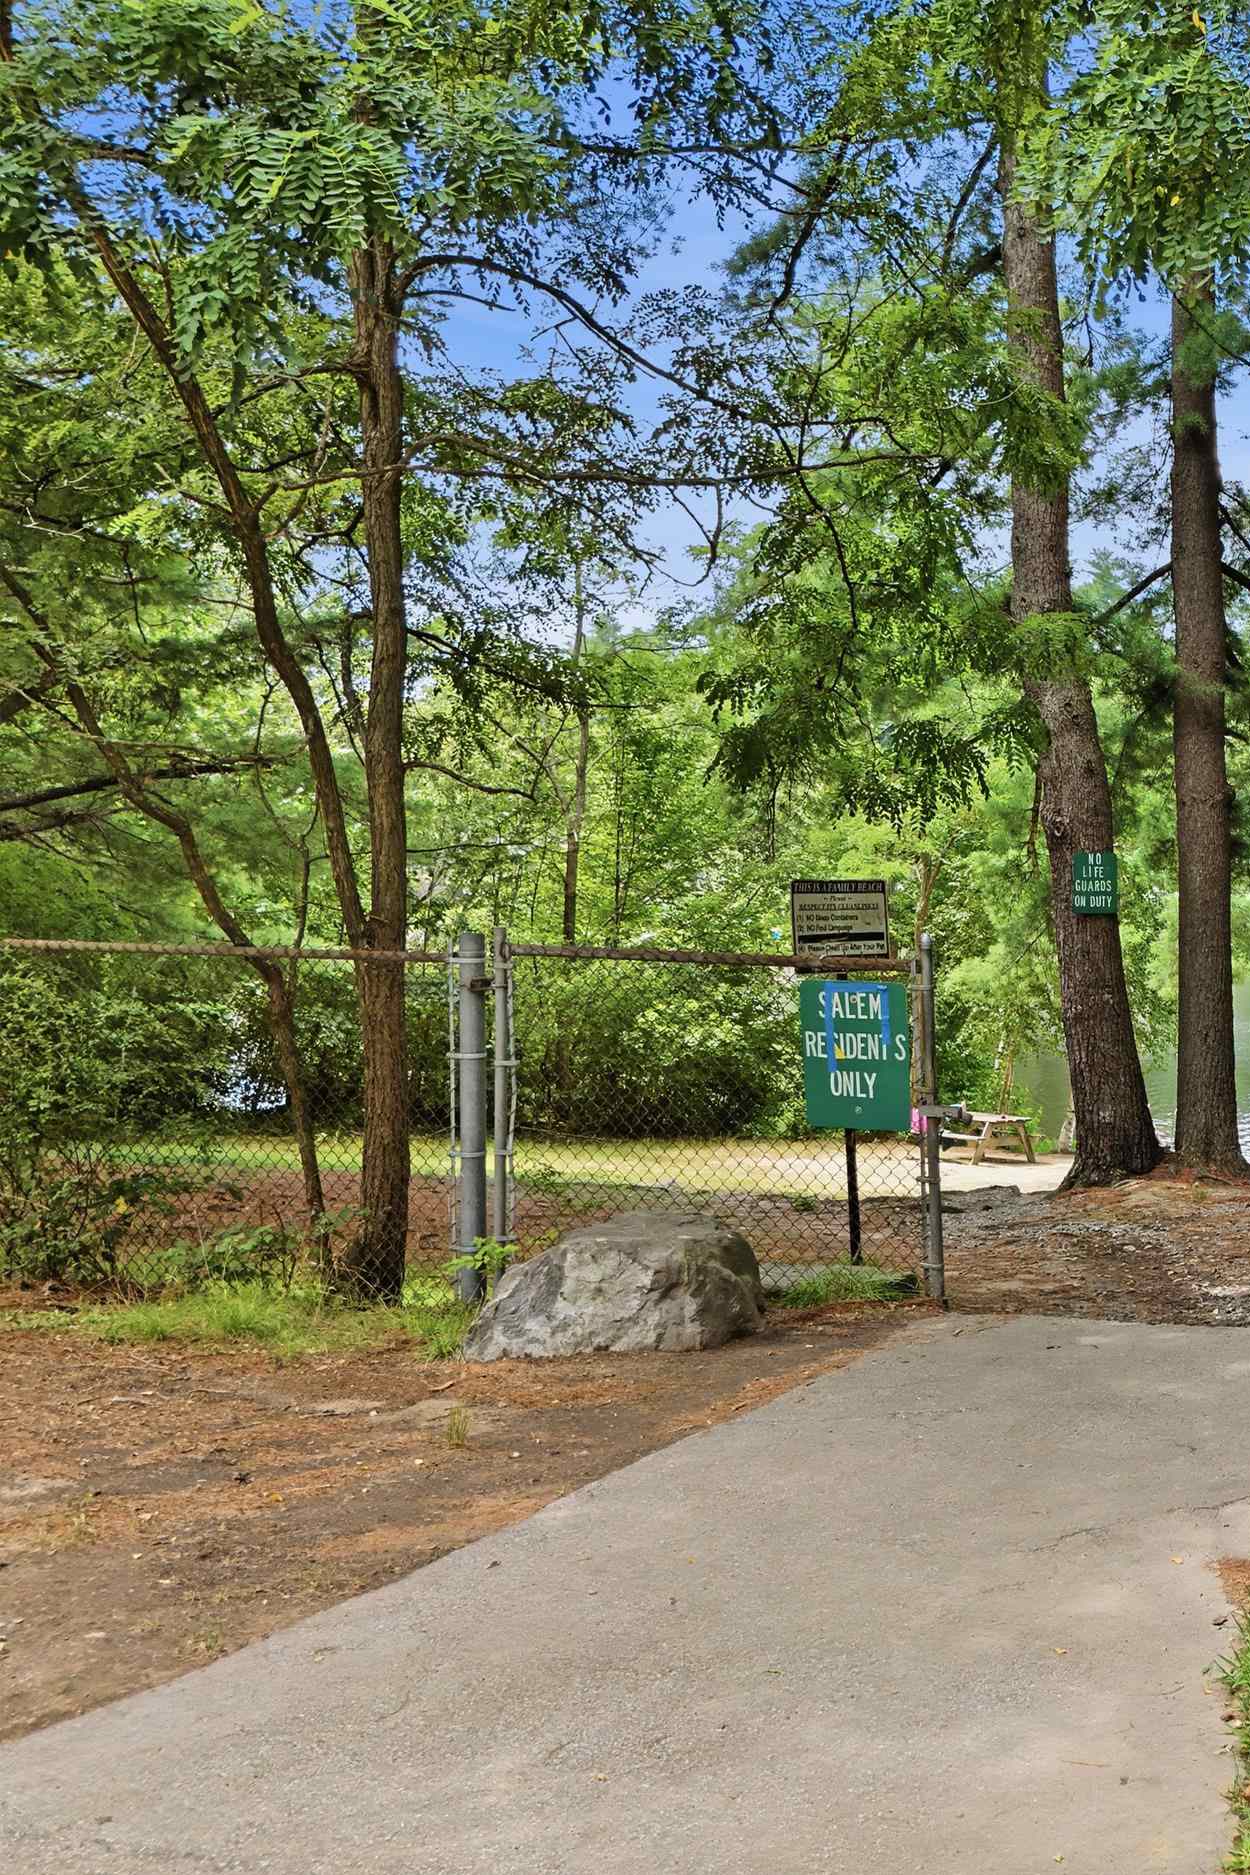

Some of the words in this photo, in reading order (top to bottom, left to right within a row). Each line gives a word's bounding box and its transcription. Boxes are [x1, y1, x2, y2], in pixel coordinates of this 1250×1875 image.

[1088, 853, 1102, 865] NO
[1082, 865, 1104, 878] LIFE
[1075, 880, 1112, 892] GUARDS
[1074, 895, 1086, 907] ON
[1090, 895, 1112, 907] DUTY
[818, 991, 882, 1019] SALEM
[804, 1031, 906, 1061] REIDENTS
[830, 1070, 877, 1099] ONLY
